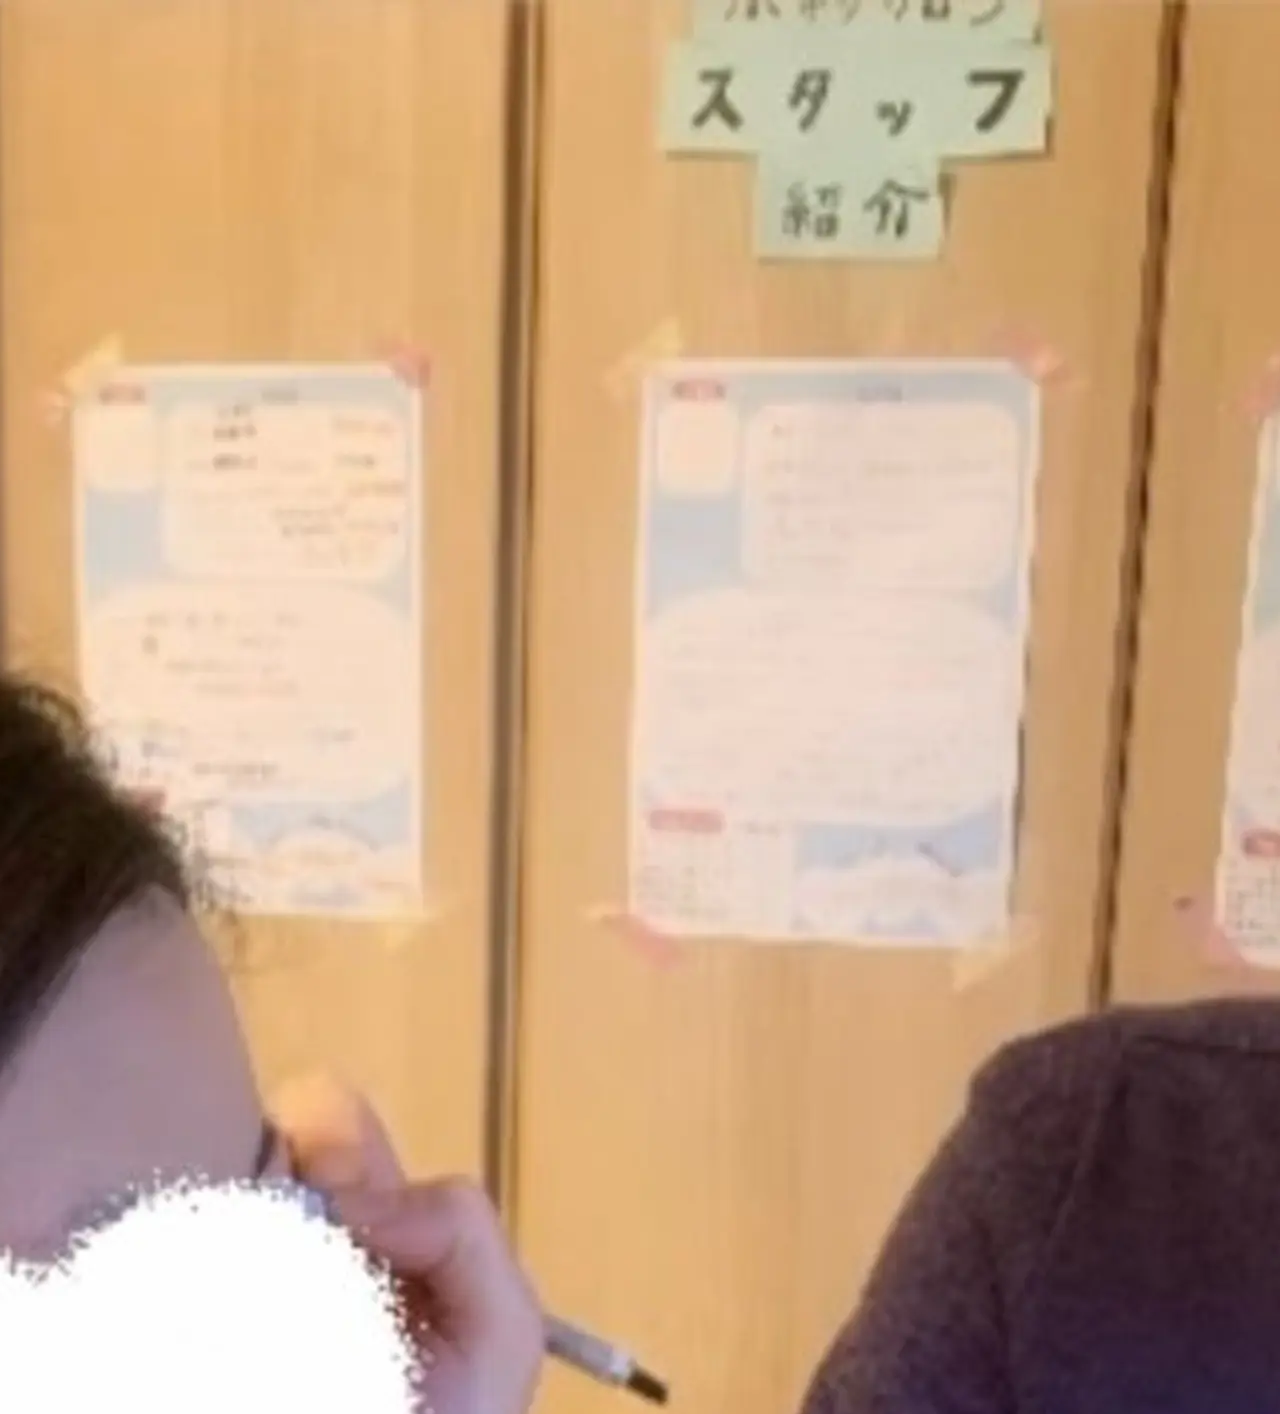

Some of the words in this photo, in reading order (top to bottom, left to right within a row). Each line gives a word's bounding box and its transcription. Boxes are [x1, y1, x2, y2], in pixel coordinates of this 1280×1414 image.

[691, 68, 1024, 136] スタッフ
[781, 178, 931, 238] 紹介
